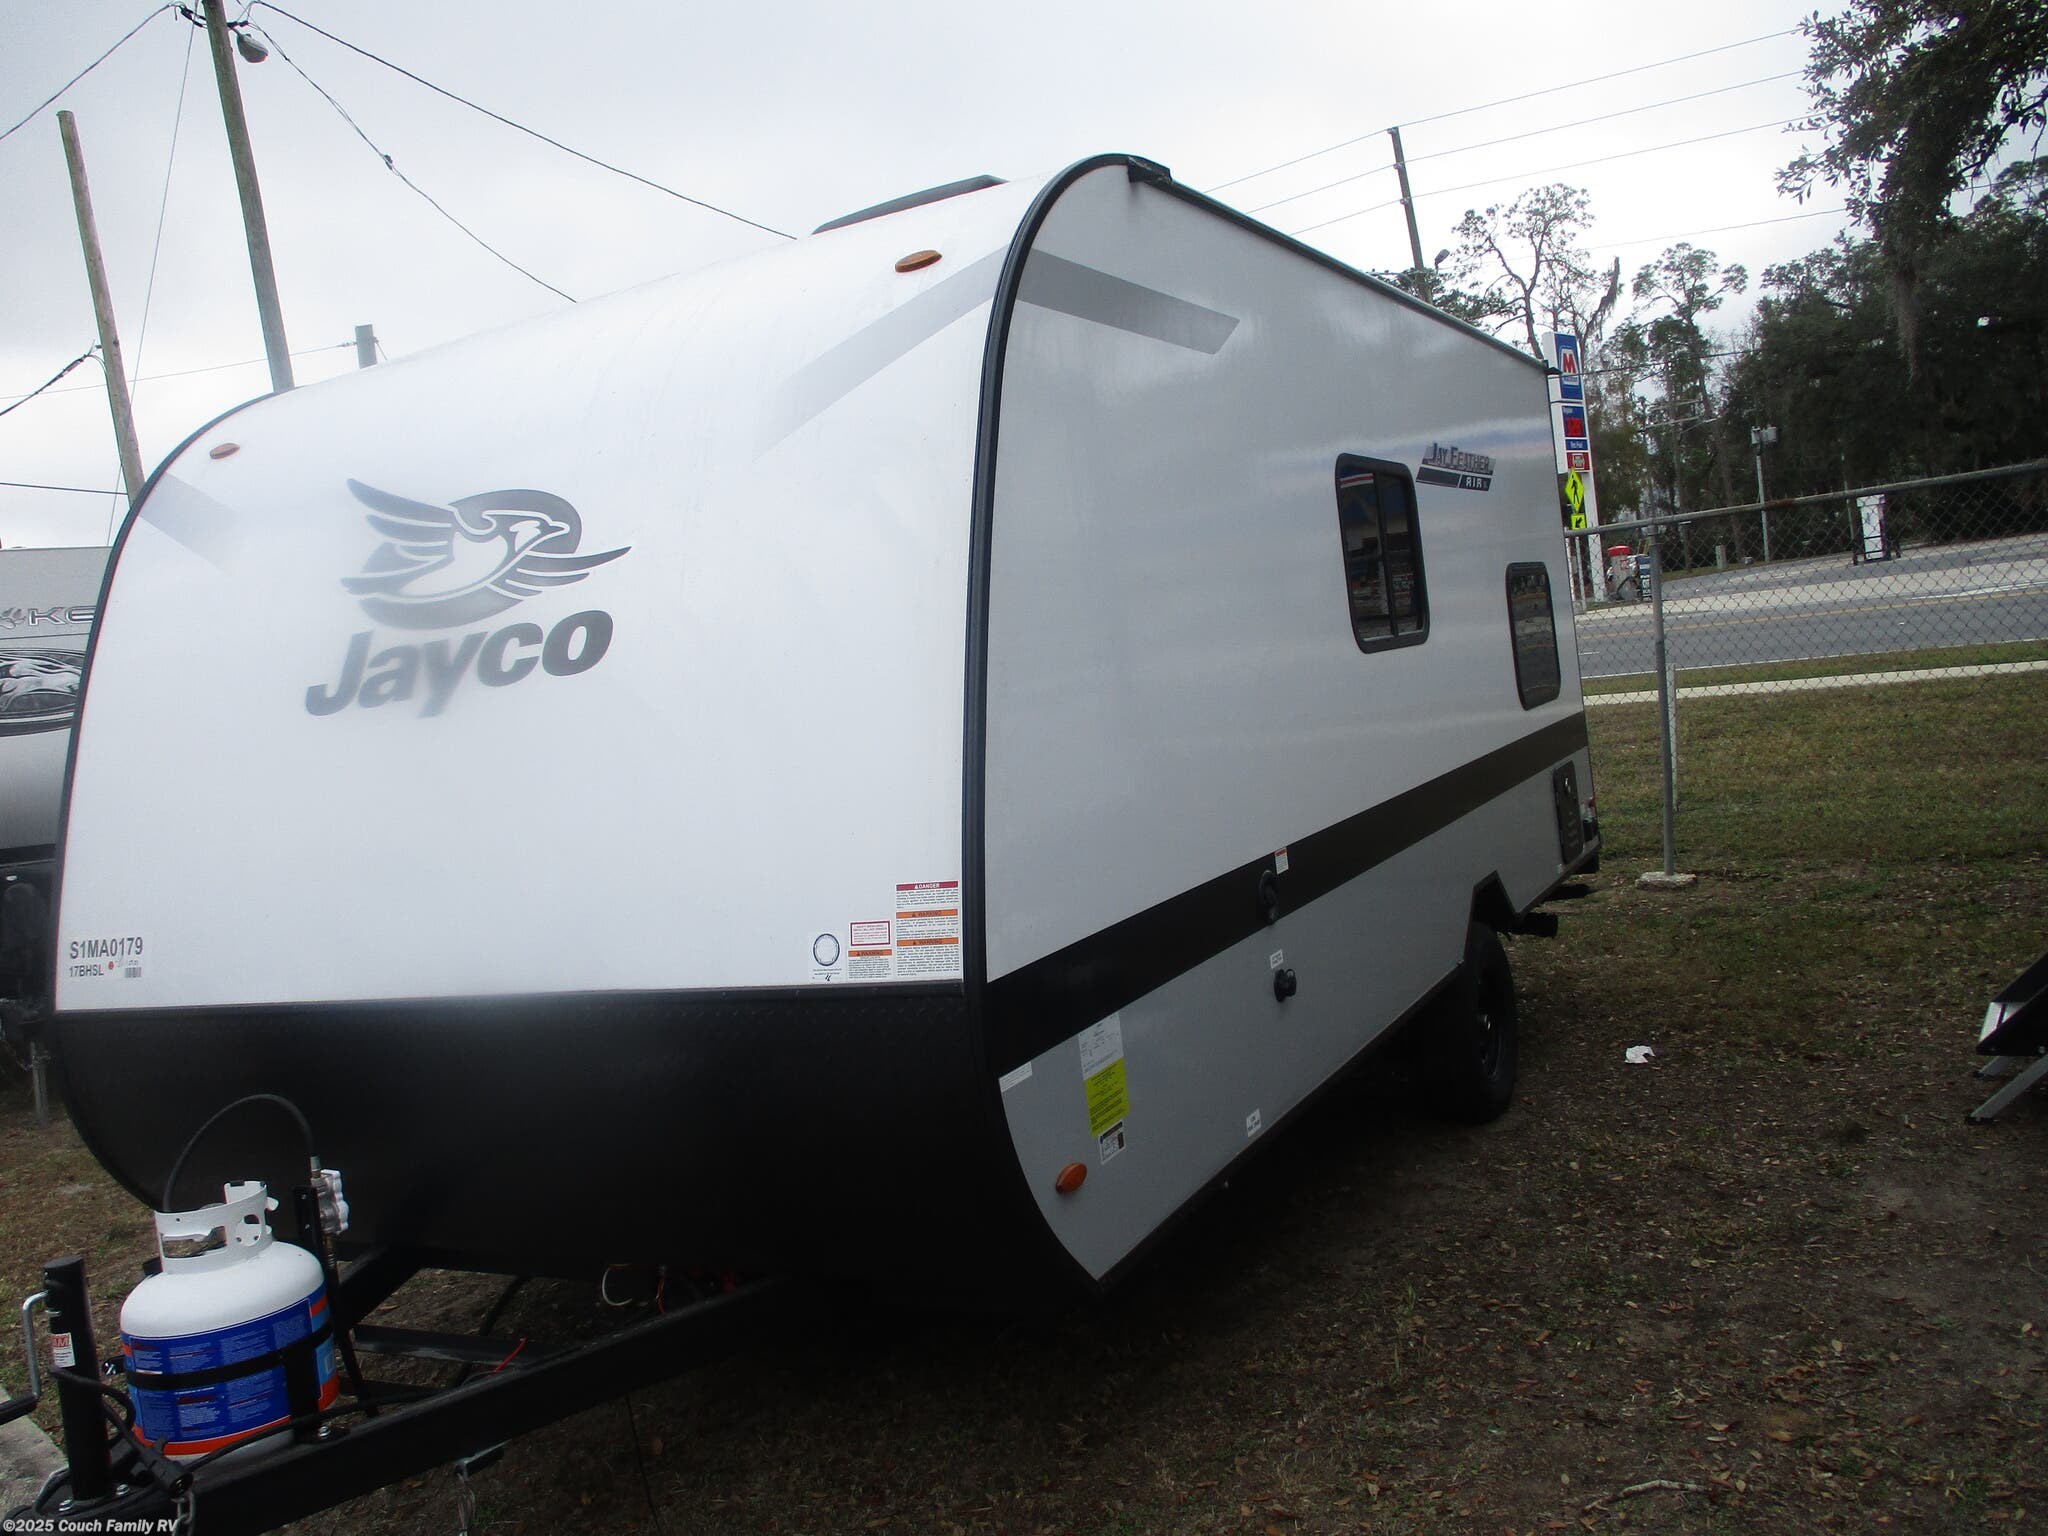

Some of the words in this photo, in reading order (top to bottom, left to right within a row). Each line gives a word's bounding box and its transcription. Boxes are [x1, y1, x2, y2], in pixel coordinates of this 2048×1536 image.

[1562, 353, 1577, 374] M
[1424, 443, 1447, 464] JAY
[1450, 446, 1489, 471] FEATHER
[1466, 477, 1482, 489] AIR
[305, 609, 614, 718] Jayco
[70, 937, 143, 959] S1MA0179
[69, 964, 104, 977] 17BHSL
